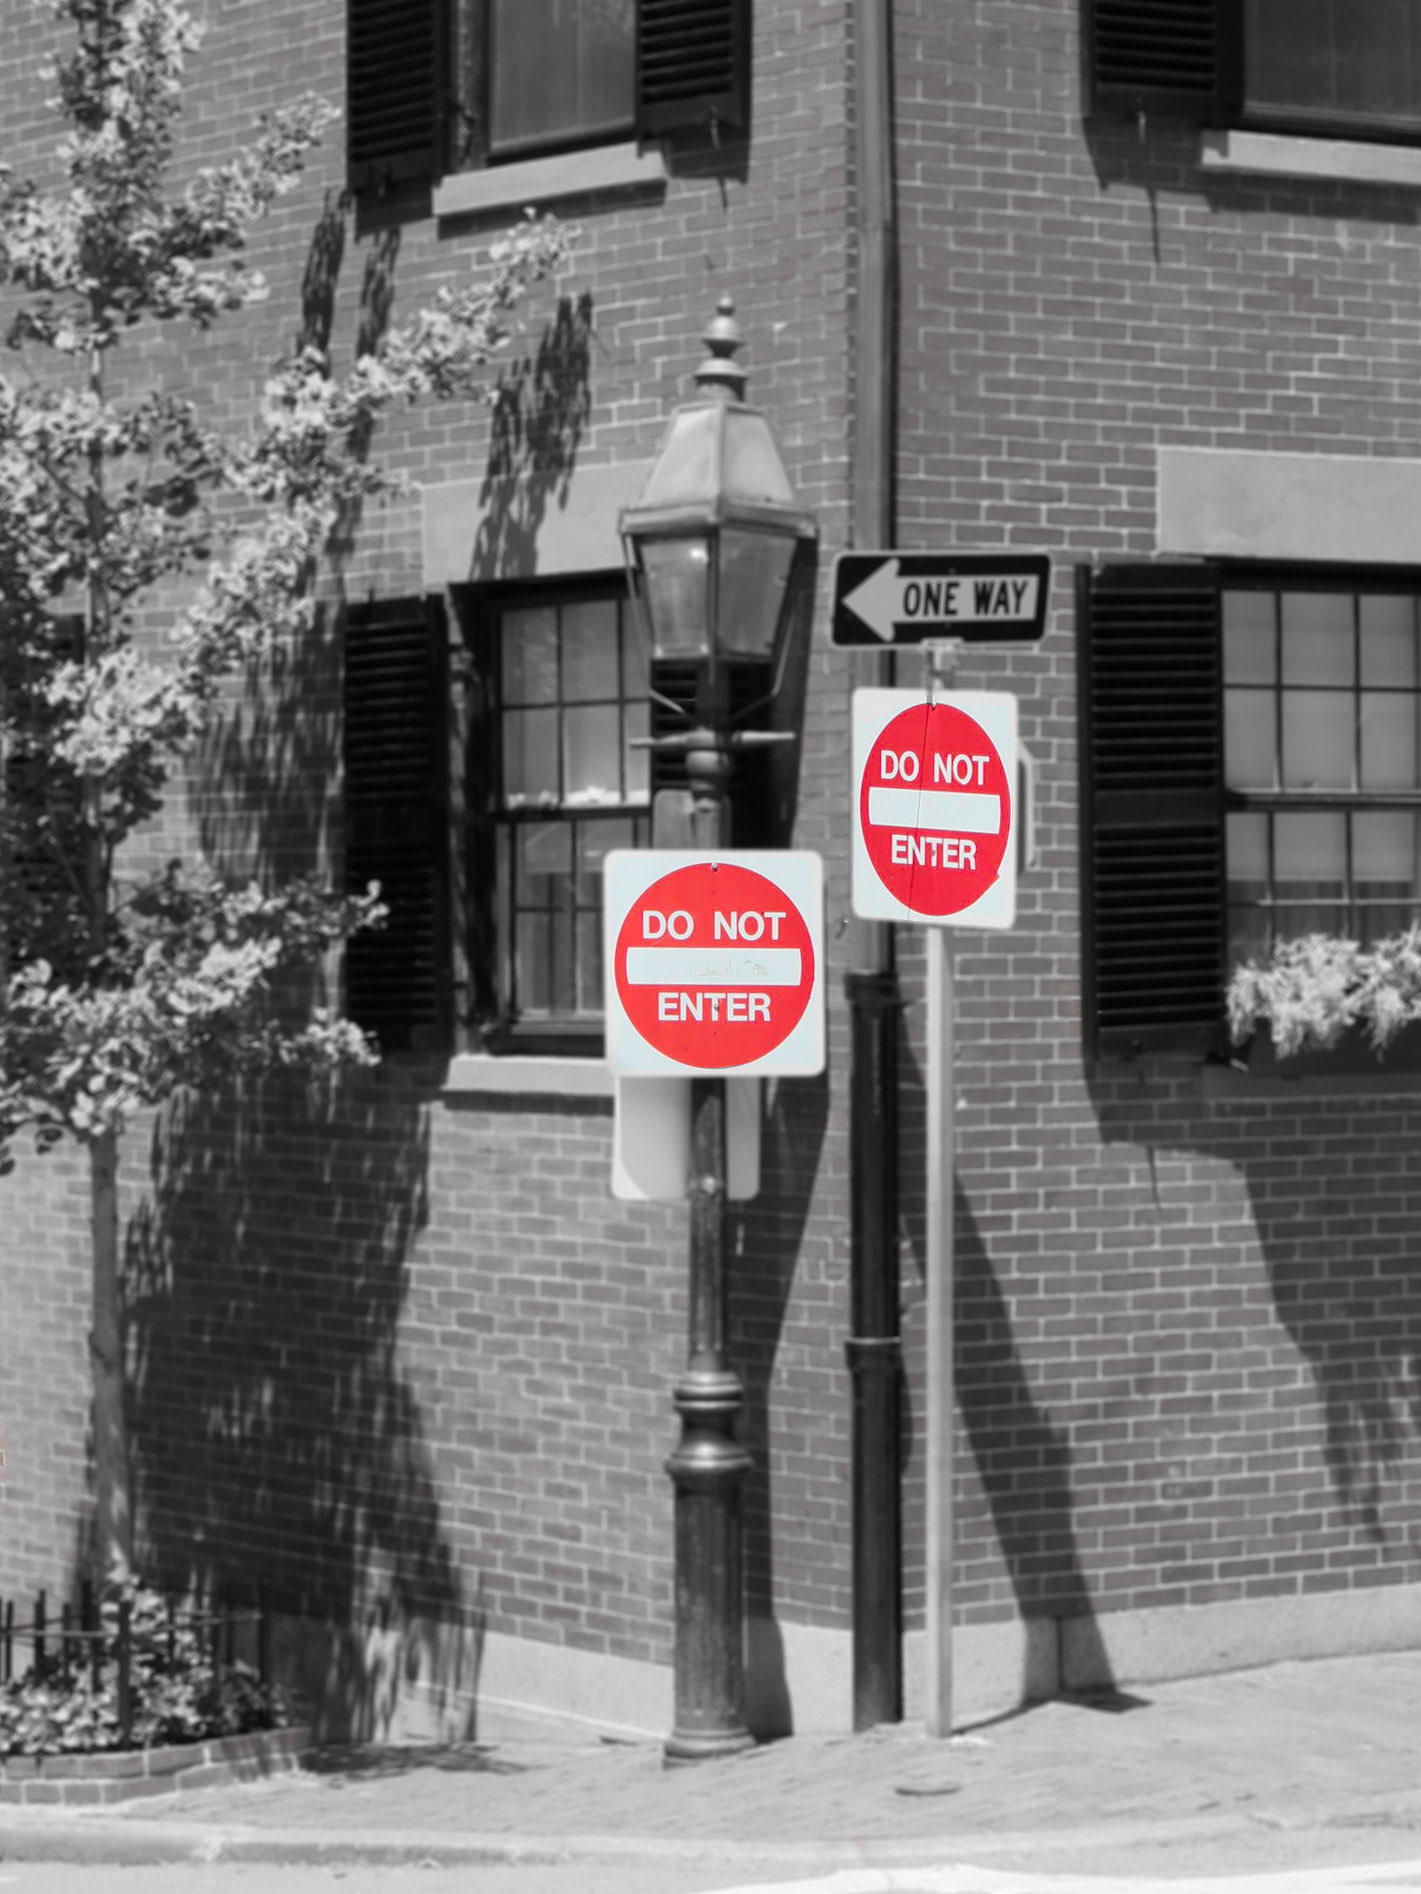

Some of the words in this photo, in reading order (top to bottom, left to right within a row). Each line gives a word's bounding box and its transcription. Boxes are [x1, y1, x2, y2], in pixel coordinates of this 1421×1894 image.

[903, 581, 960, 617] ONE
[974, 580, 1029, 615] WAY
[880, 749, 920, 782] DO
[933, 752, 990, 786] NOT
[891, 833, 977, 870] ENTER
[642, 909, 695, 941] DO
[714, 910, 787, 941] NOT
[658, 991, 771, 1022] ENTER
